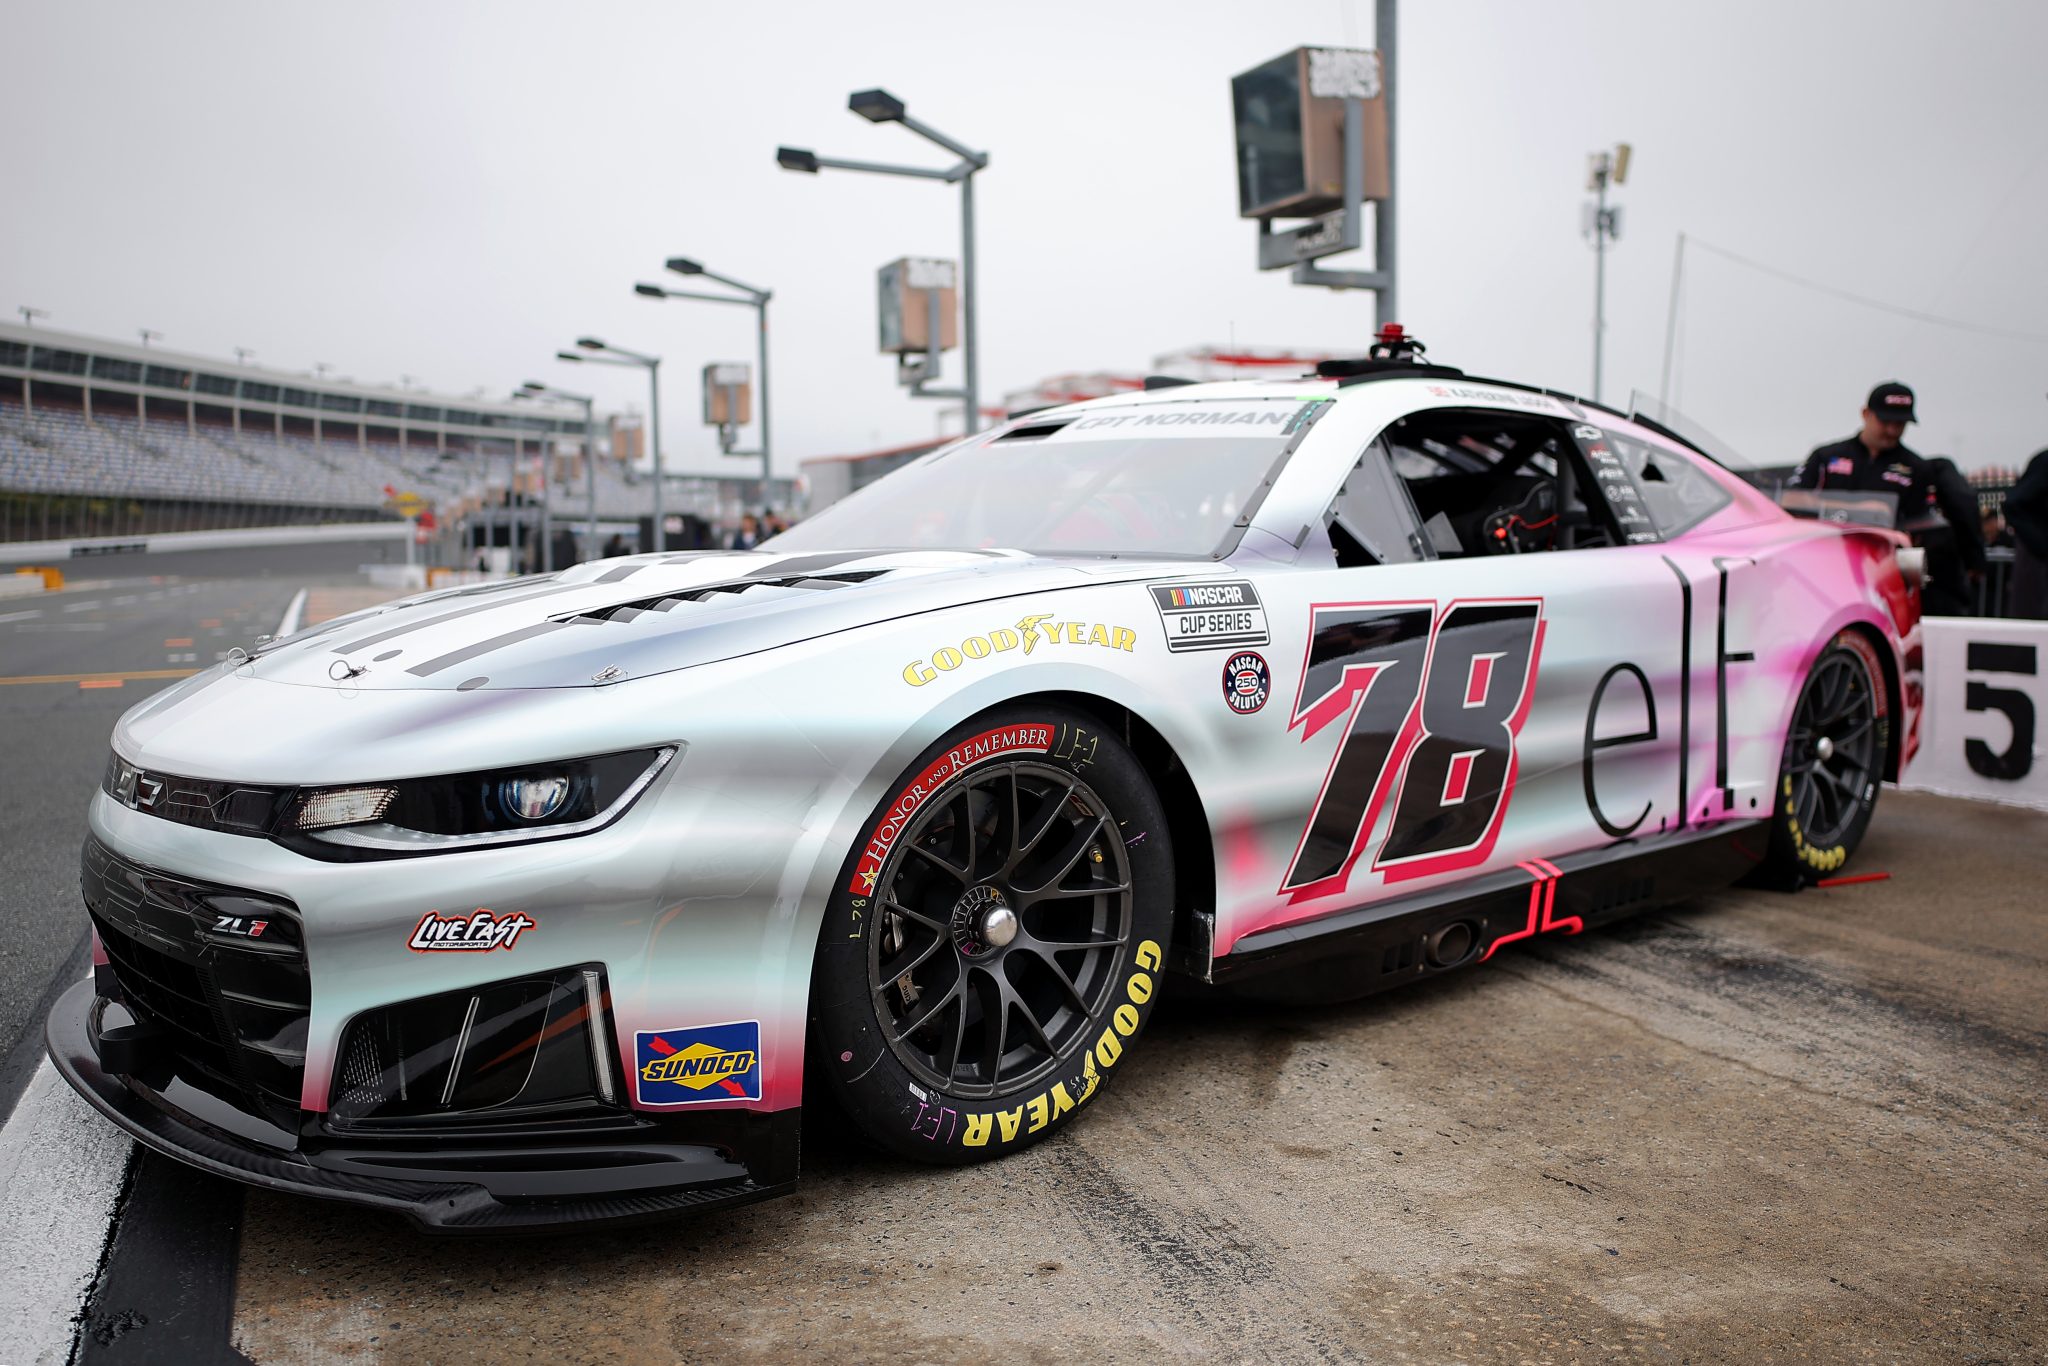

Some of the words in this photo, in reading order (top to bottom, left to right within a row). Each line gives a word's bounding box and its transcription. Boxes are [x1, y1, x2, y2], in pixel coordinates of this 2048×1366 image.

[1075, 415, 1137, 430] CPT
[1138, 411, 1290, 427] NORMAN
[1188, 586, 1244, 606] NASCAR
[1180, 615, 1206, 634] CUP
[1208, 612, 1252, 632] SERIES
[902, 620, 1137, 687] GOODYEAR
[1228, 656, 1264, 676] NASCAR
[1236, 677, 1258, 688] 250
[1229, 687, 1266, 709] SALUTES
[1964, 641, 2037, 782] 5
[1278, 597, 1547, 906] 78
[866, 785, 928, 862] HONOR
[928, 765, 949, 787] AND
[948, 728, 1048, 773] REMEMBER
[212, 915, 269, 937] ZL1
[410, 914, 466, 948] LIVE
[963, 939, 1162, 1147] GOODYEAR
[646, 1053, 751, 1080] SUNOCO
